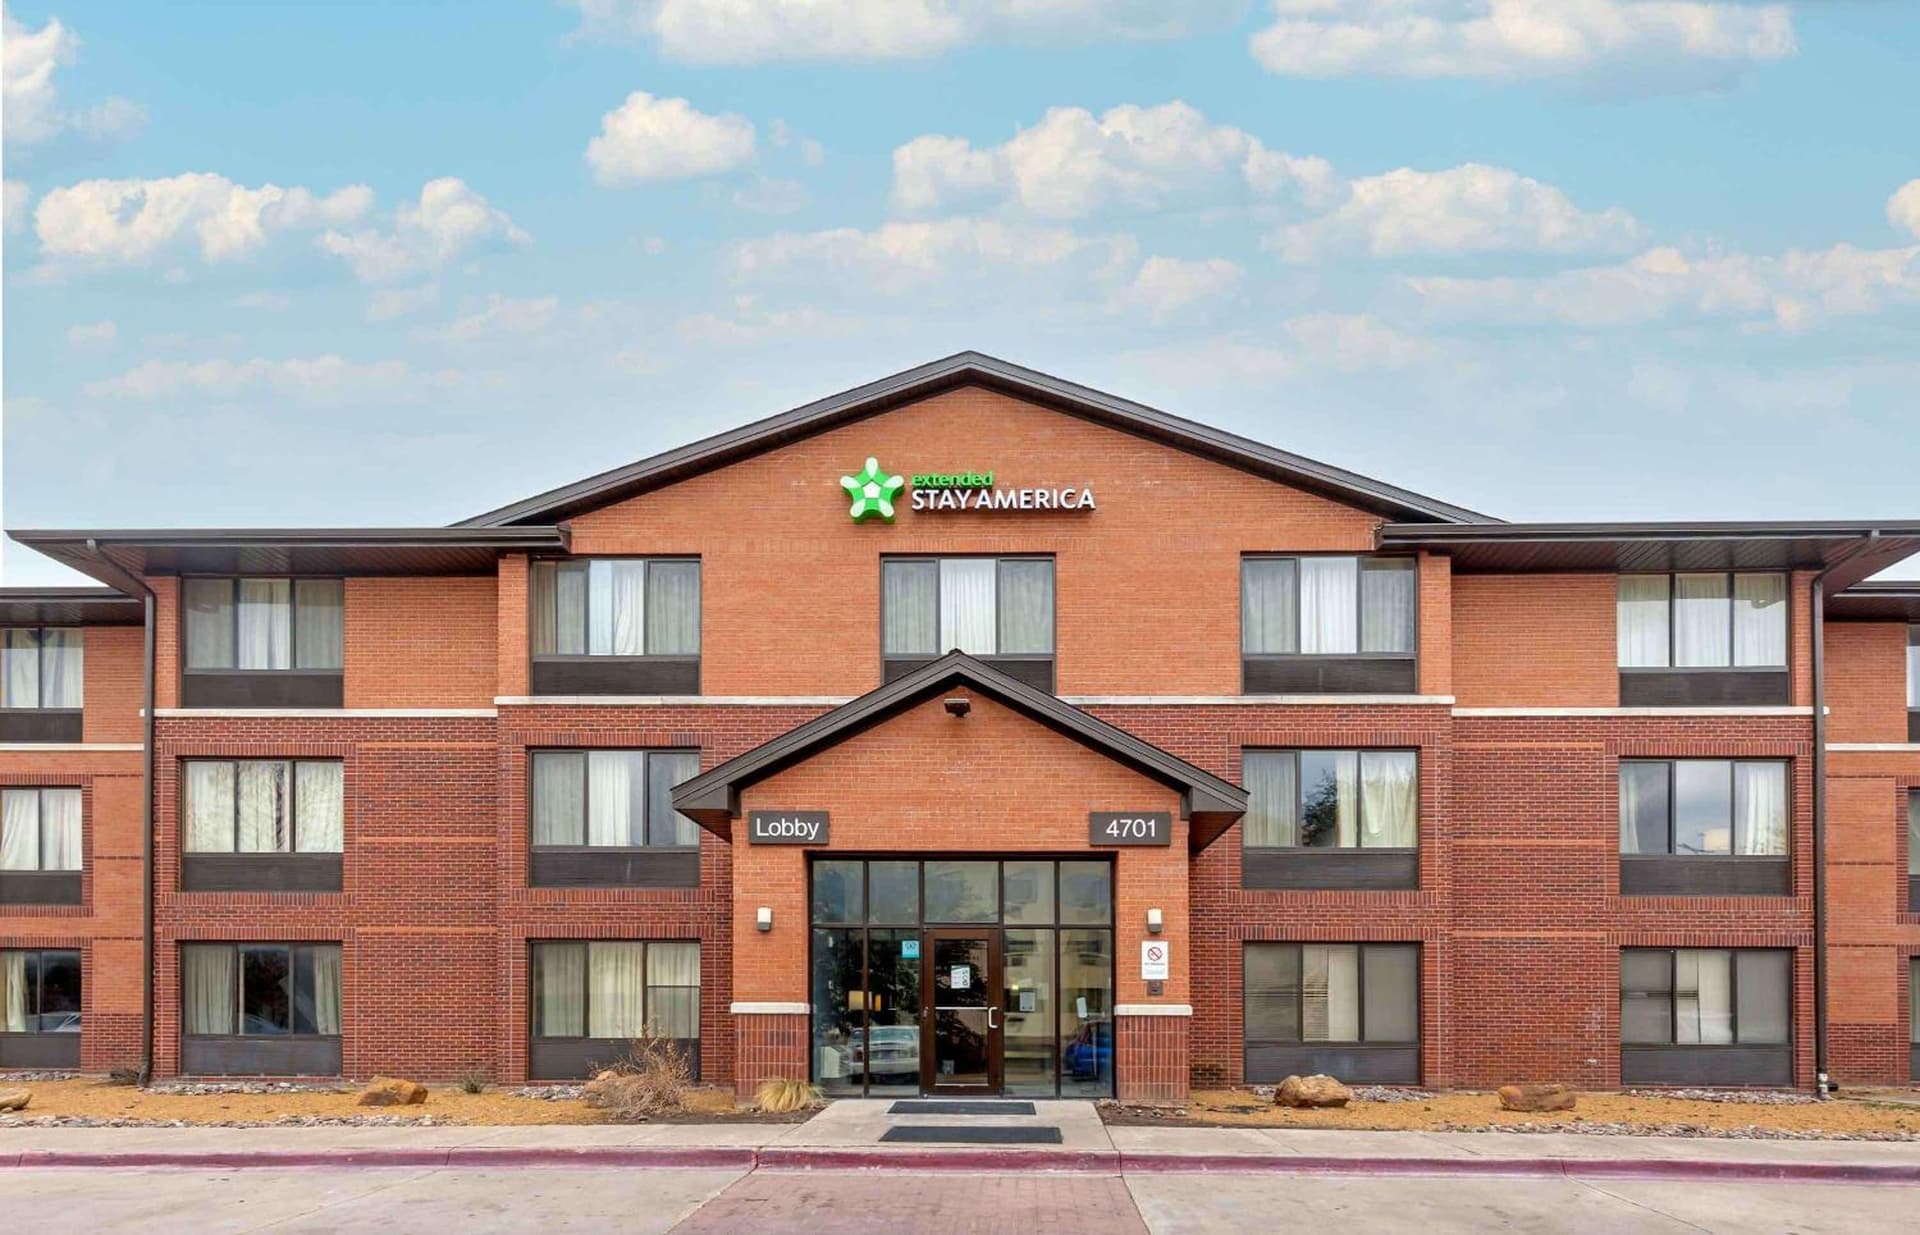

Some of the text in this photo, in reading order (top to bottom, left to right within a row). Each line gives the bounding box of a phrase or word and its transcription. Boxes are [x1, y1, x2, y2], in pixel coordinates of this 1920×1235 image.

[911, 471, 994, 487] extended
[911, 489, 1096, 510] STAY AMERICA
[756, 818, 820, 841] Lobby
[1105, 818, 1156, 837] 4701
